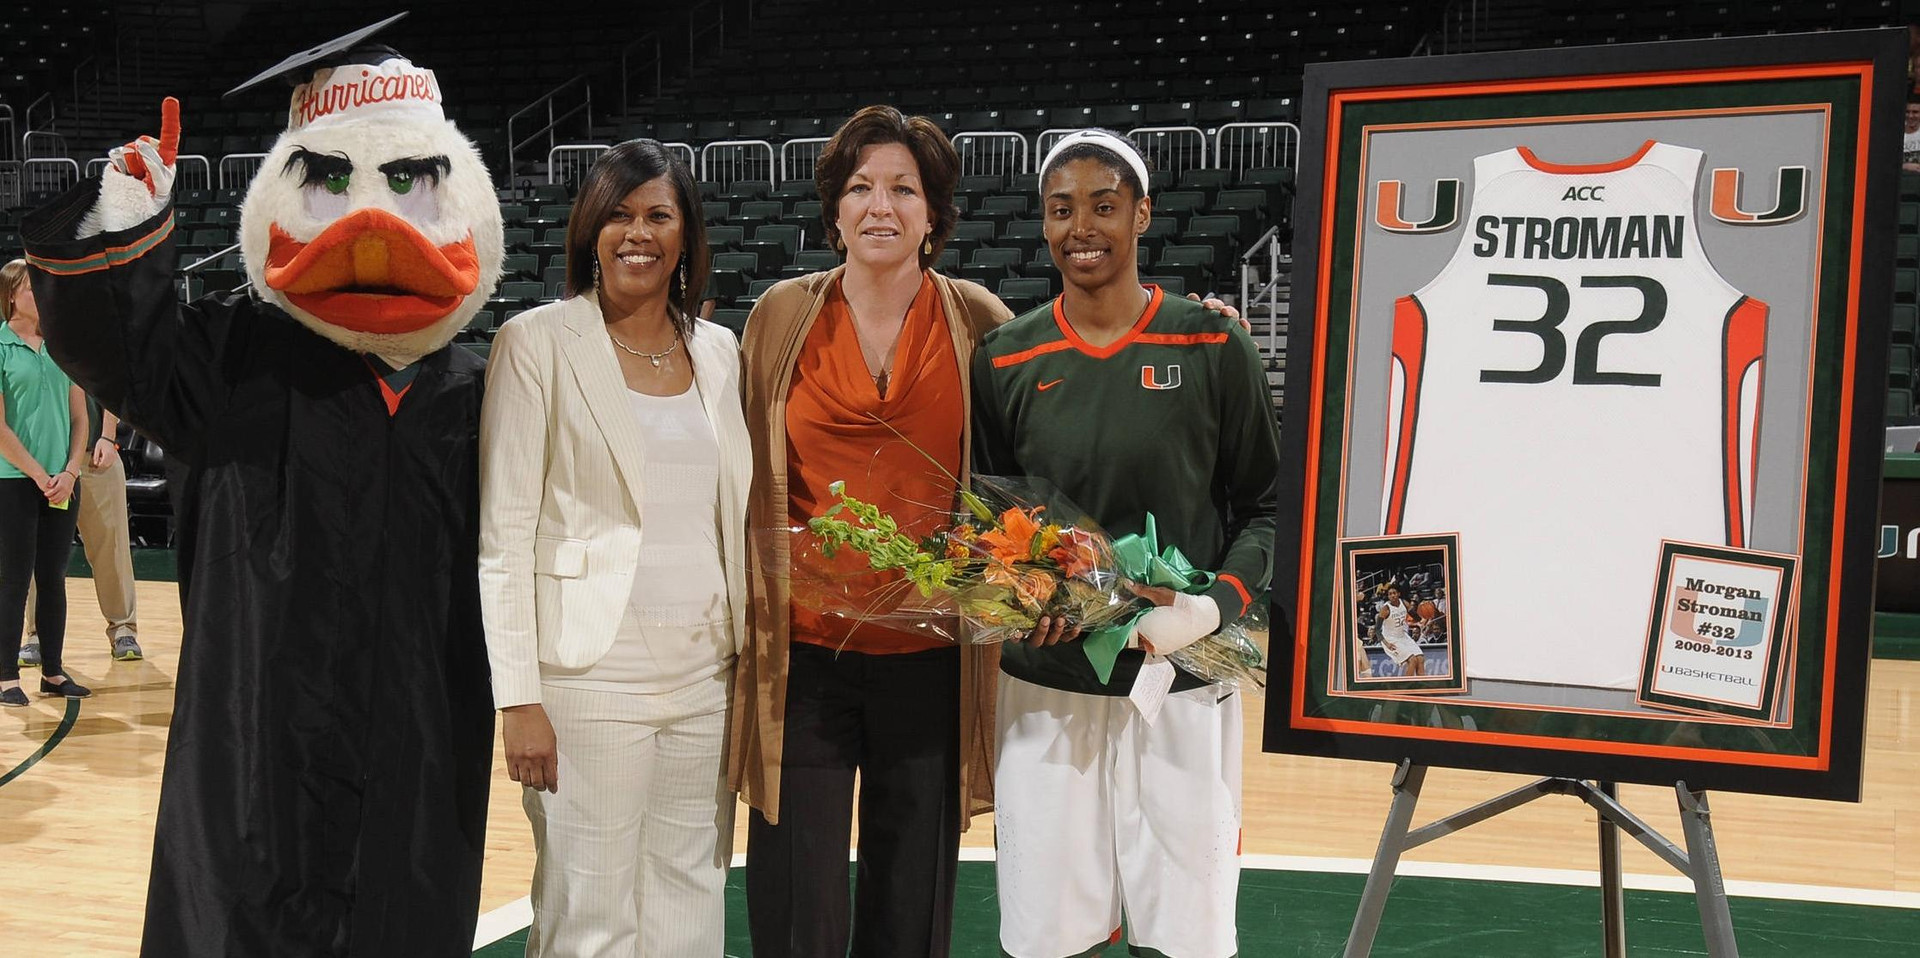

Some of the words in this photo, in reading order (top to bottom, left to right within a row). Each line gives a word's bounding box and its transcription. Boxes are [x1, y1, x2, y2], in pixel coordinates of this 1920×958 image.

[299, 70, 435, 127] Hurricanes
[1375, 178, 1460, 232] U
[1561, 186, 1605, 202] ACC
[1710, 166, 1806, 224] U
[1474, 214, 1685, 260] STROMAN
[1479, 272, 1668, 387] 32
[1141, 364, 1181, 390] U
[1684, 577, 1762, 600] Morgan
[1677, 598, 1763, 622] Stroman
[1697, 622, 1736, 640] #32
[1674, 639, 1753, 660] 2009-2013
